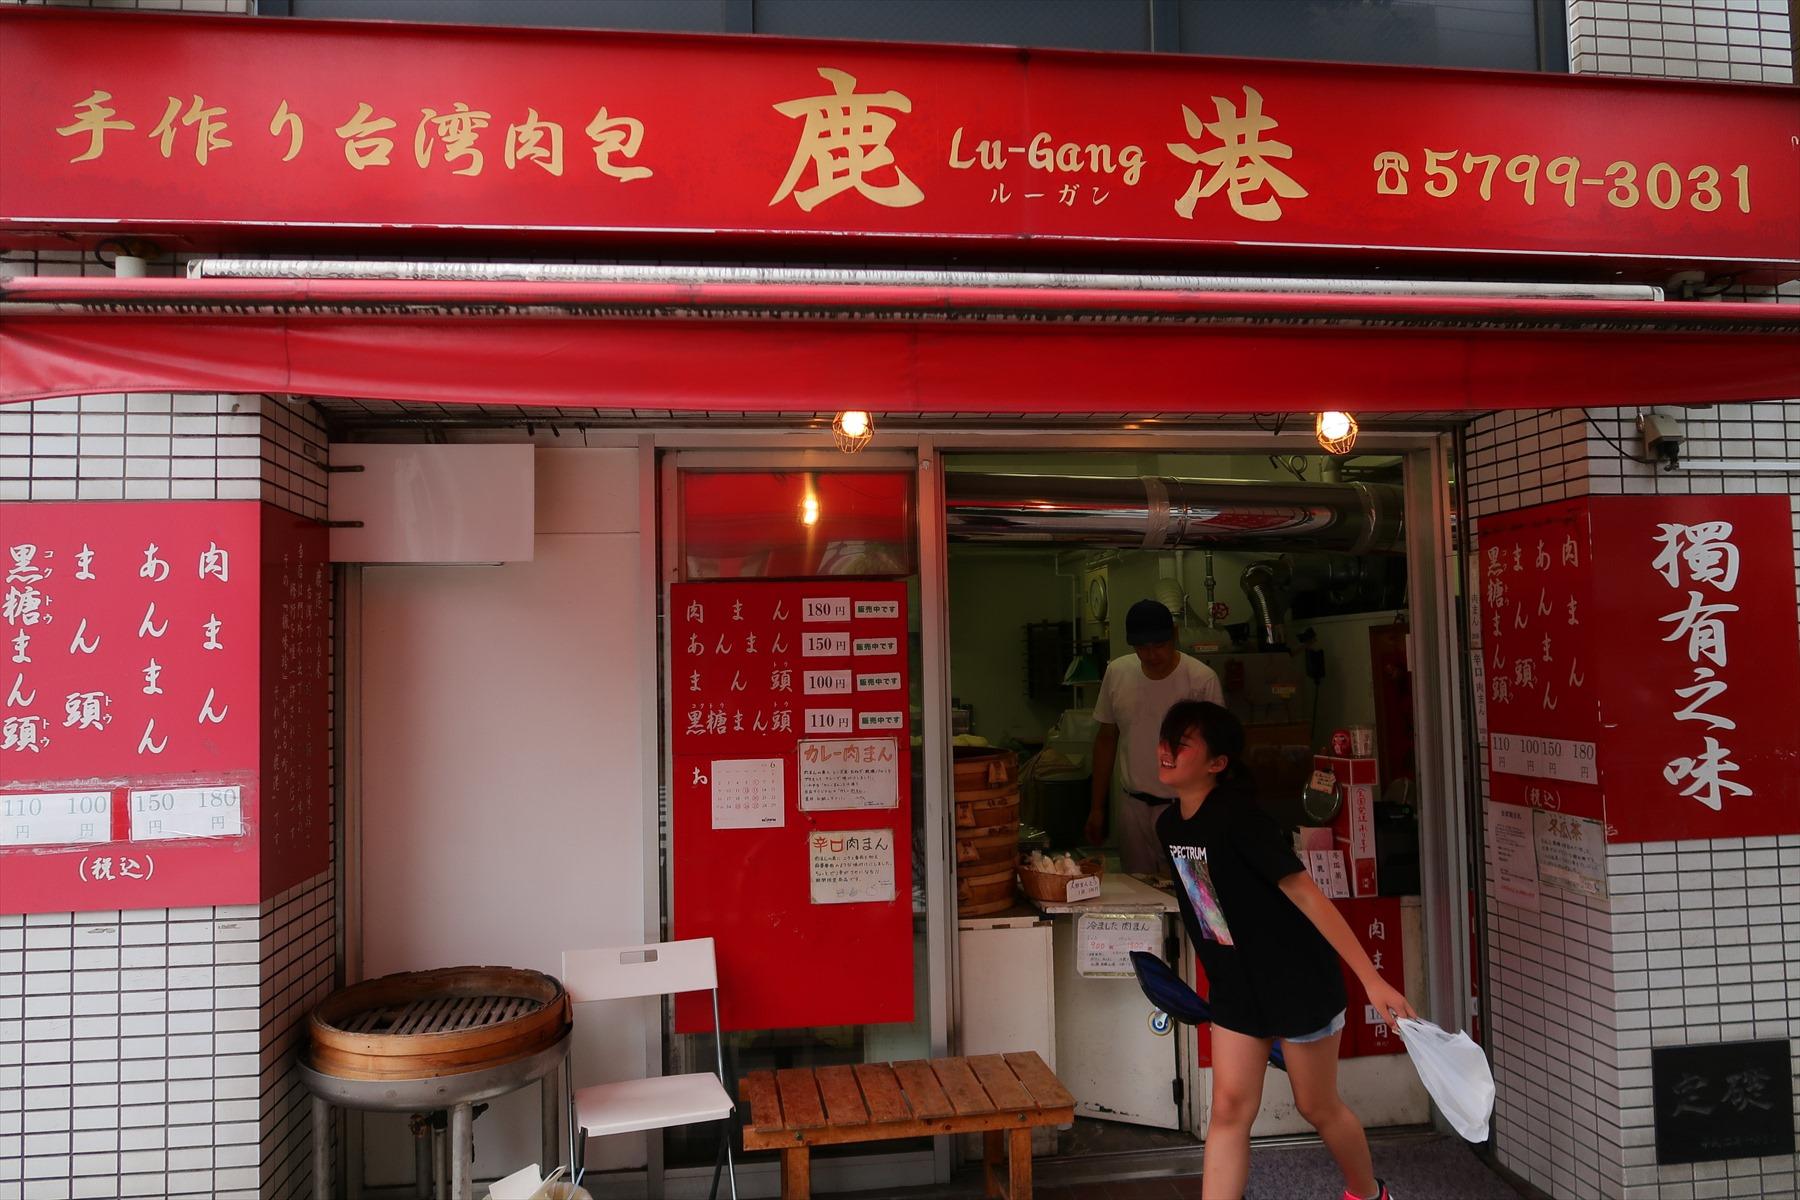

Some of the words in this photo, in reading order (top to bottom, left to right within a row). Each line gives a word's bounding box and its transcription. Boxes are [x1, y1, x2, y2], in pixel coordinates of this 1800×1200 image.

[56, 90, 653, 183] 手作り台湾肉包
[769, 67, 925, 213] 鹿
[948, 127, 1147, 186] Lu-Gang
[1166, 85, 1309, 222] 港
[1424, 148, 1751, 214] 5799-3031
[991, 183, 1110, 206] ルーガン
[687, 600, 789, 623] 肉まん
[807, 603, 831, 616] 180
[835, 606, 845, 616] 円
[857, 605, 896, 614] 販売中です
[1512, 543, 1534, 688] まん頭
[1562, 535, 1584, 687] 肉まん
[198, 541, 230, 724] 肉まん
[1487, 546, 1509, 704] 黒糖まん頭
[1535, 539, 1558, 710] あんまん
[62, 543, 104, 731] まん頭
[688, 632, 788, 656] あんまん
[808, 637, 832, 651] 150
[836, 641, 846, 651] 円
[856, 642, 894, 651] 販売中です
[1, 544, 44, 753] 黒糖まん頭
[138, 542, 170, 754] あんまん
[1652, 521, 1753, 811] 獨有之味
[690, 669, 793, 693] まん頭
[809, 676, 833, 689] 100
[835, 679, 845, 689] 円
[859, 677, 898, 686] 販売中です
[686, 709, 793, 735] 黒糖まん頭
[811, 714, 835, 728] 110
[838, 717, 849, 728] 円
[861, 716, 900, 725] 販売中です
[1493, 736, 1509, 750] 110
[1521, 739, 1539, 755] 100
[1542, 742, 1561, 757] 150
[1573, 743, 1595, 760] 180
[804, 744, 893, 763] カレー肉まん
[4, 798, 42, 816] 110
[67, 797, 106, 814] 100
[136, 793, 174, 812] 150
[199, 789, 236, 808] 180
[16, 825, 30, 839] 円
[80, 823, 94, 837] 円
[149, 820, 162, 834] 円
[211, 816, 225, 830] 円
[812, 836, 889, 853] 辛口肉まん
[1169, 845, 1208, 863] SPECTRUM
[79, 855, 154, 882] (税込)
[1375, 1024, 1388, 1038] 円
